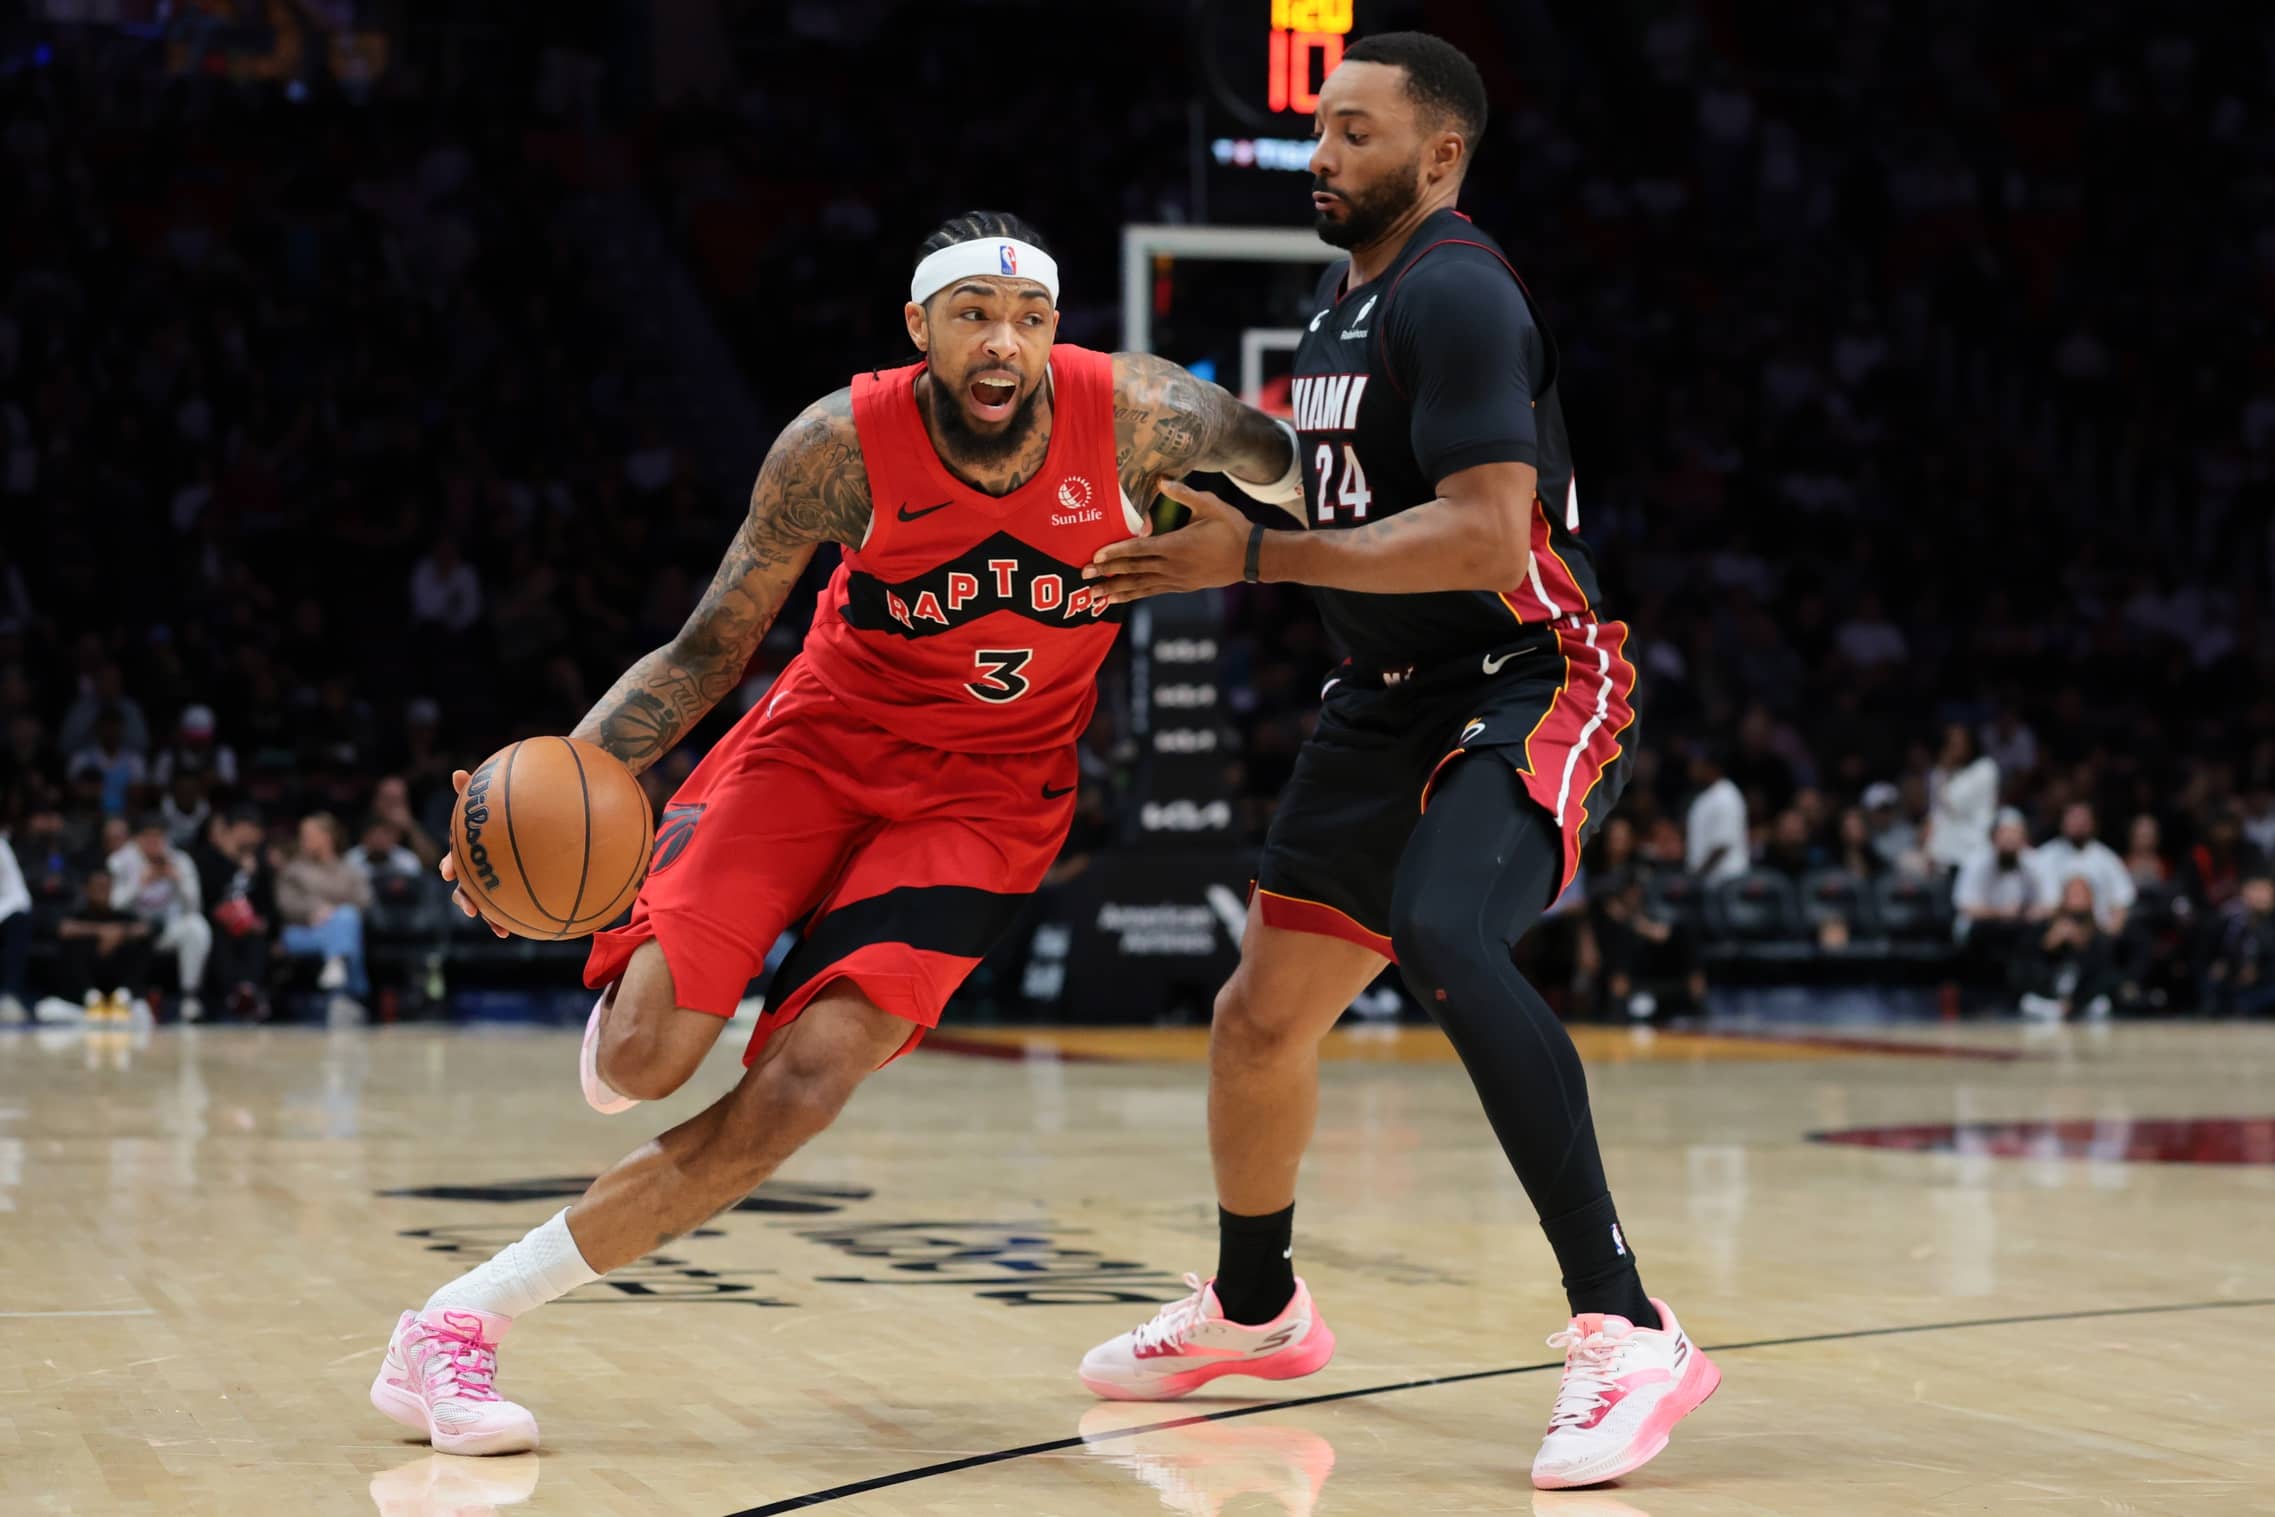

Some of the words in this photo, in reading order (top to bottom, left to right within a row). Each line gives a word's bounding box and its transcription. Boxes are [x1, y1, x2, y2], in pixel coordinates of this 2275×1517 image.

[1268, 31, 1344, 113] 10
[1051, 513, 1077, 526] Sun
[1079, 508, 1103, 522] Life
[1314, 440, 1371, 524] 24
[963, 648, 1034, 704] 3
[464, 757, 500, 891] Wilson
